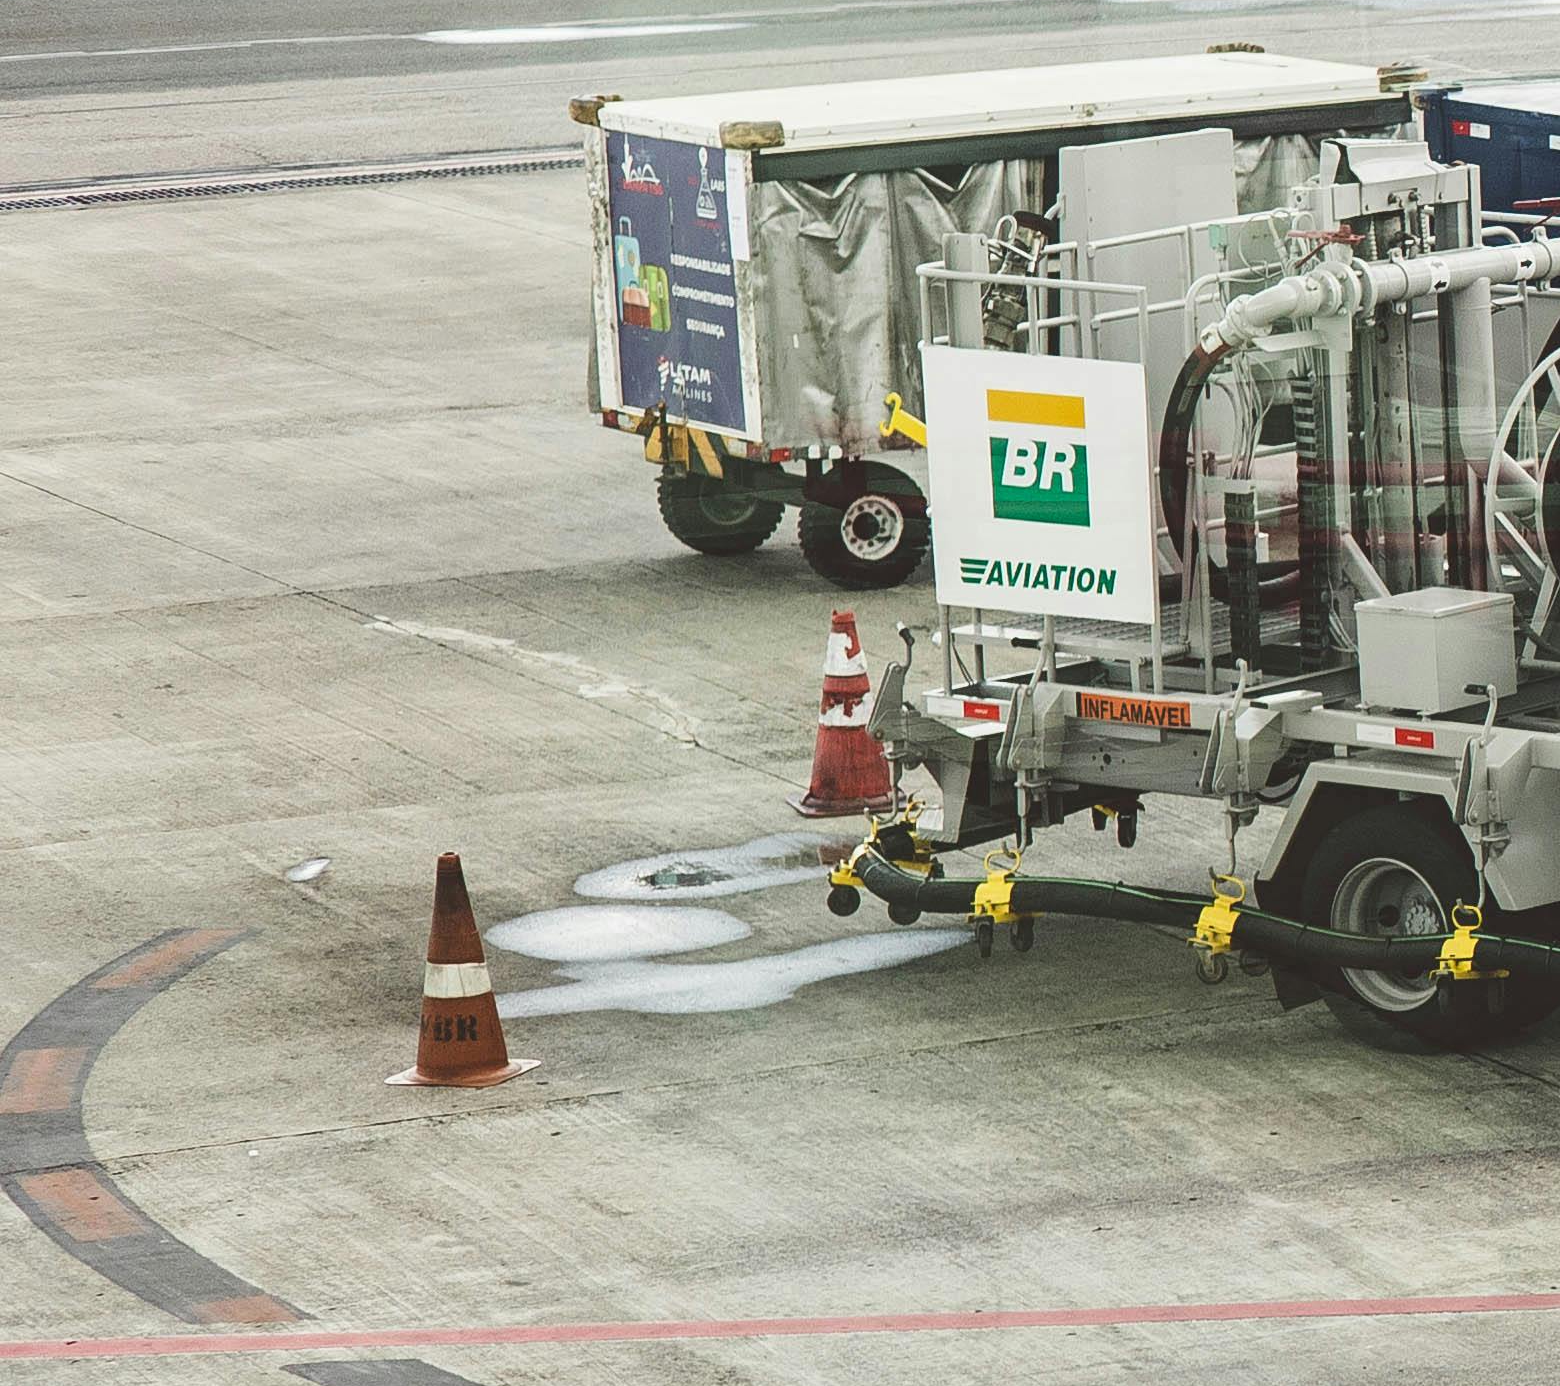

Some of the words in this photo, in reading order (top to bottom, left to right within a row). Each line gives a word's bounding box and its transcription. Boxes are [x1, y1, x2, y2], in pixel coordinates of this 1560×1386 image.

[669, 360, 712, 386] LATAM
[1001, 437, 1077, 493] BR
[985, 560, 1117, 595] AVIATION
[1082, 693, 1191, 727] INFLAMÁVEL
